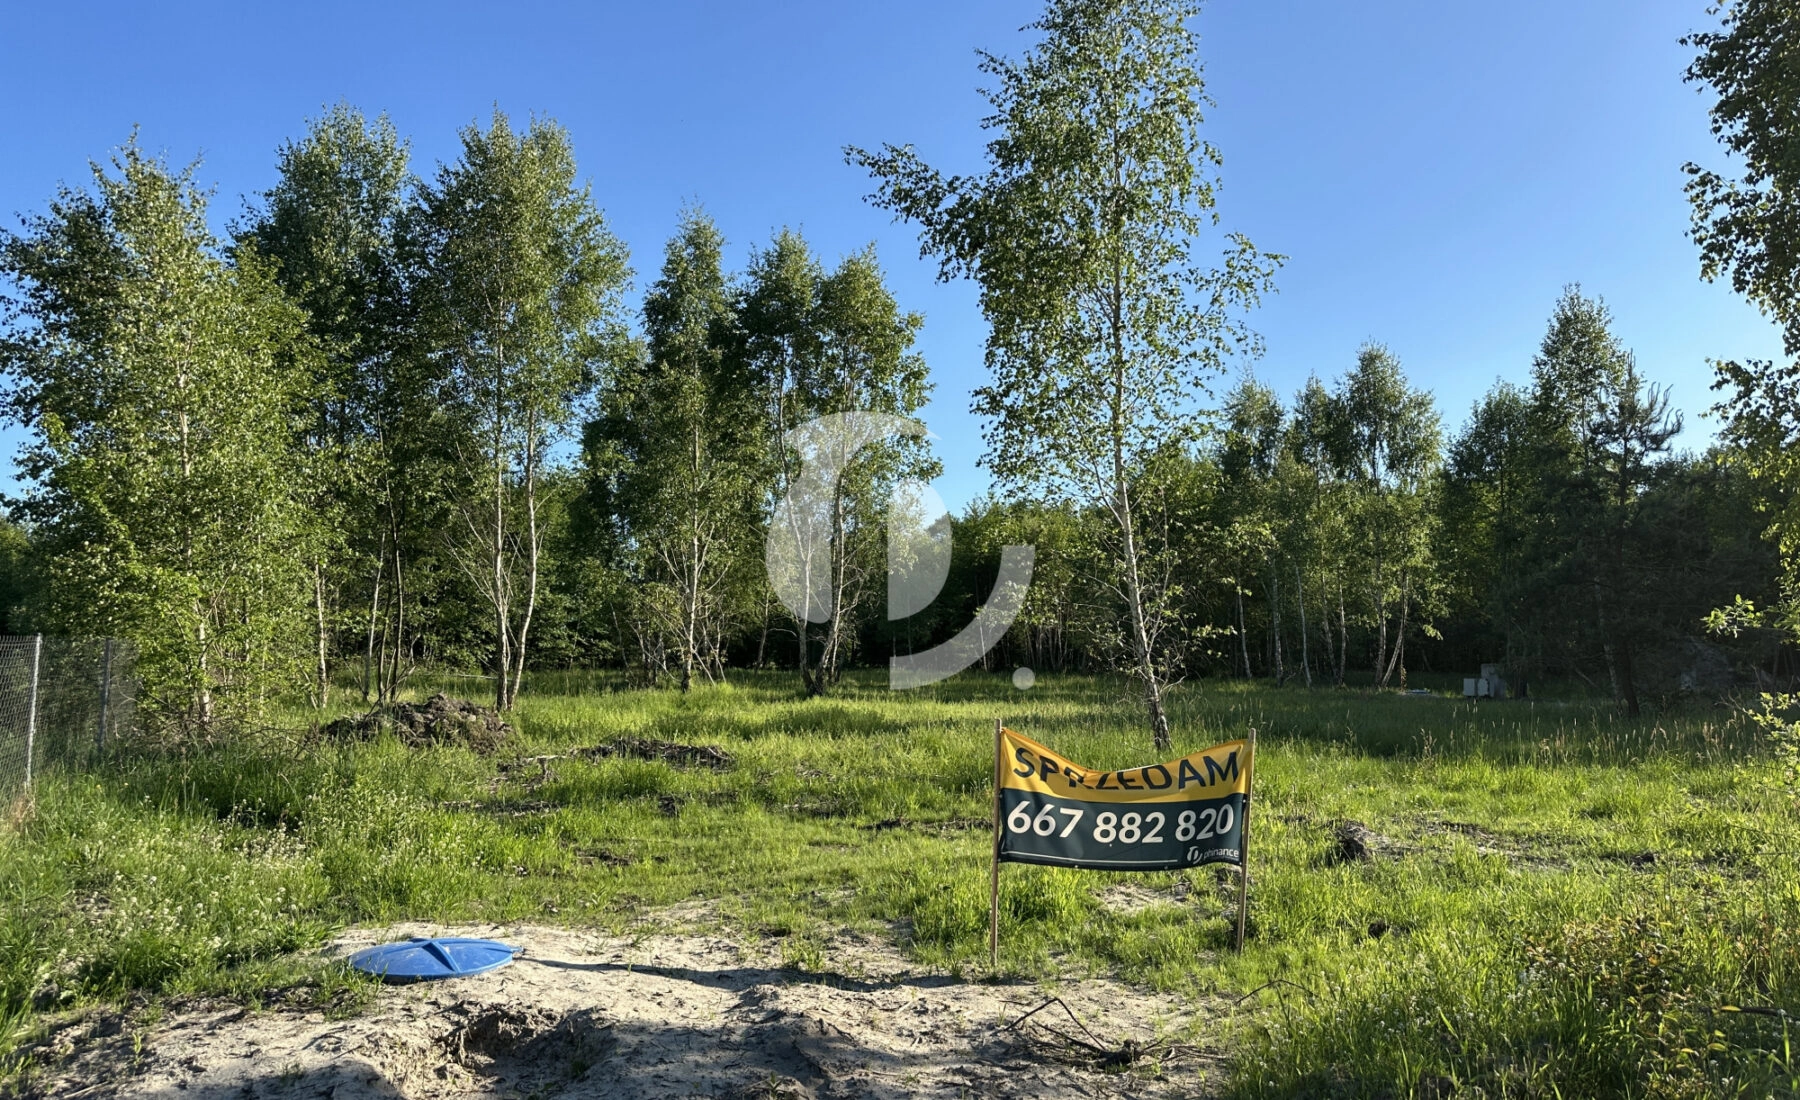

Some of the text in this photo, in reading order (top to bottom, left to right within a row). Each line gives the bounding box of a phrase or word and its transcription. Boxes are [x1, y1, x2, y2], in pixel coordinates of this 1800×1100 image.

[1007, 801, 1234, 844] 667 882 820
